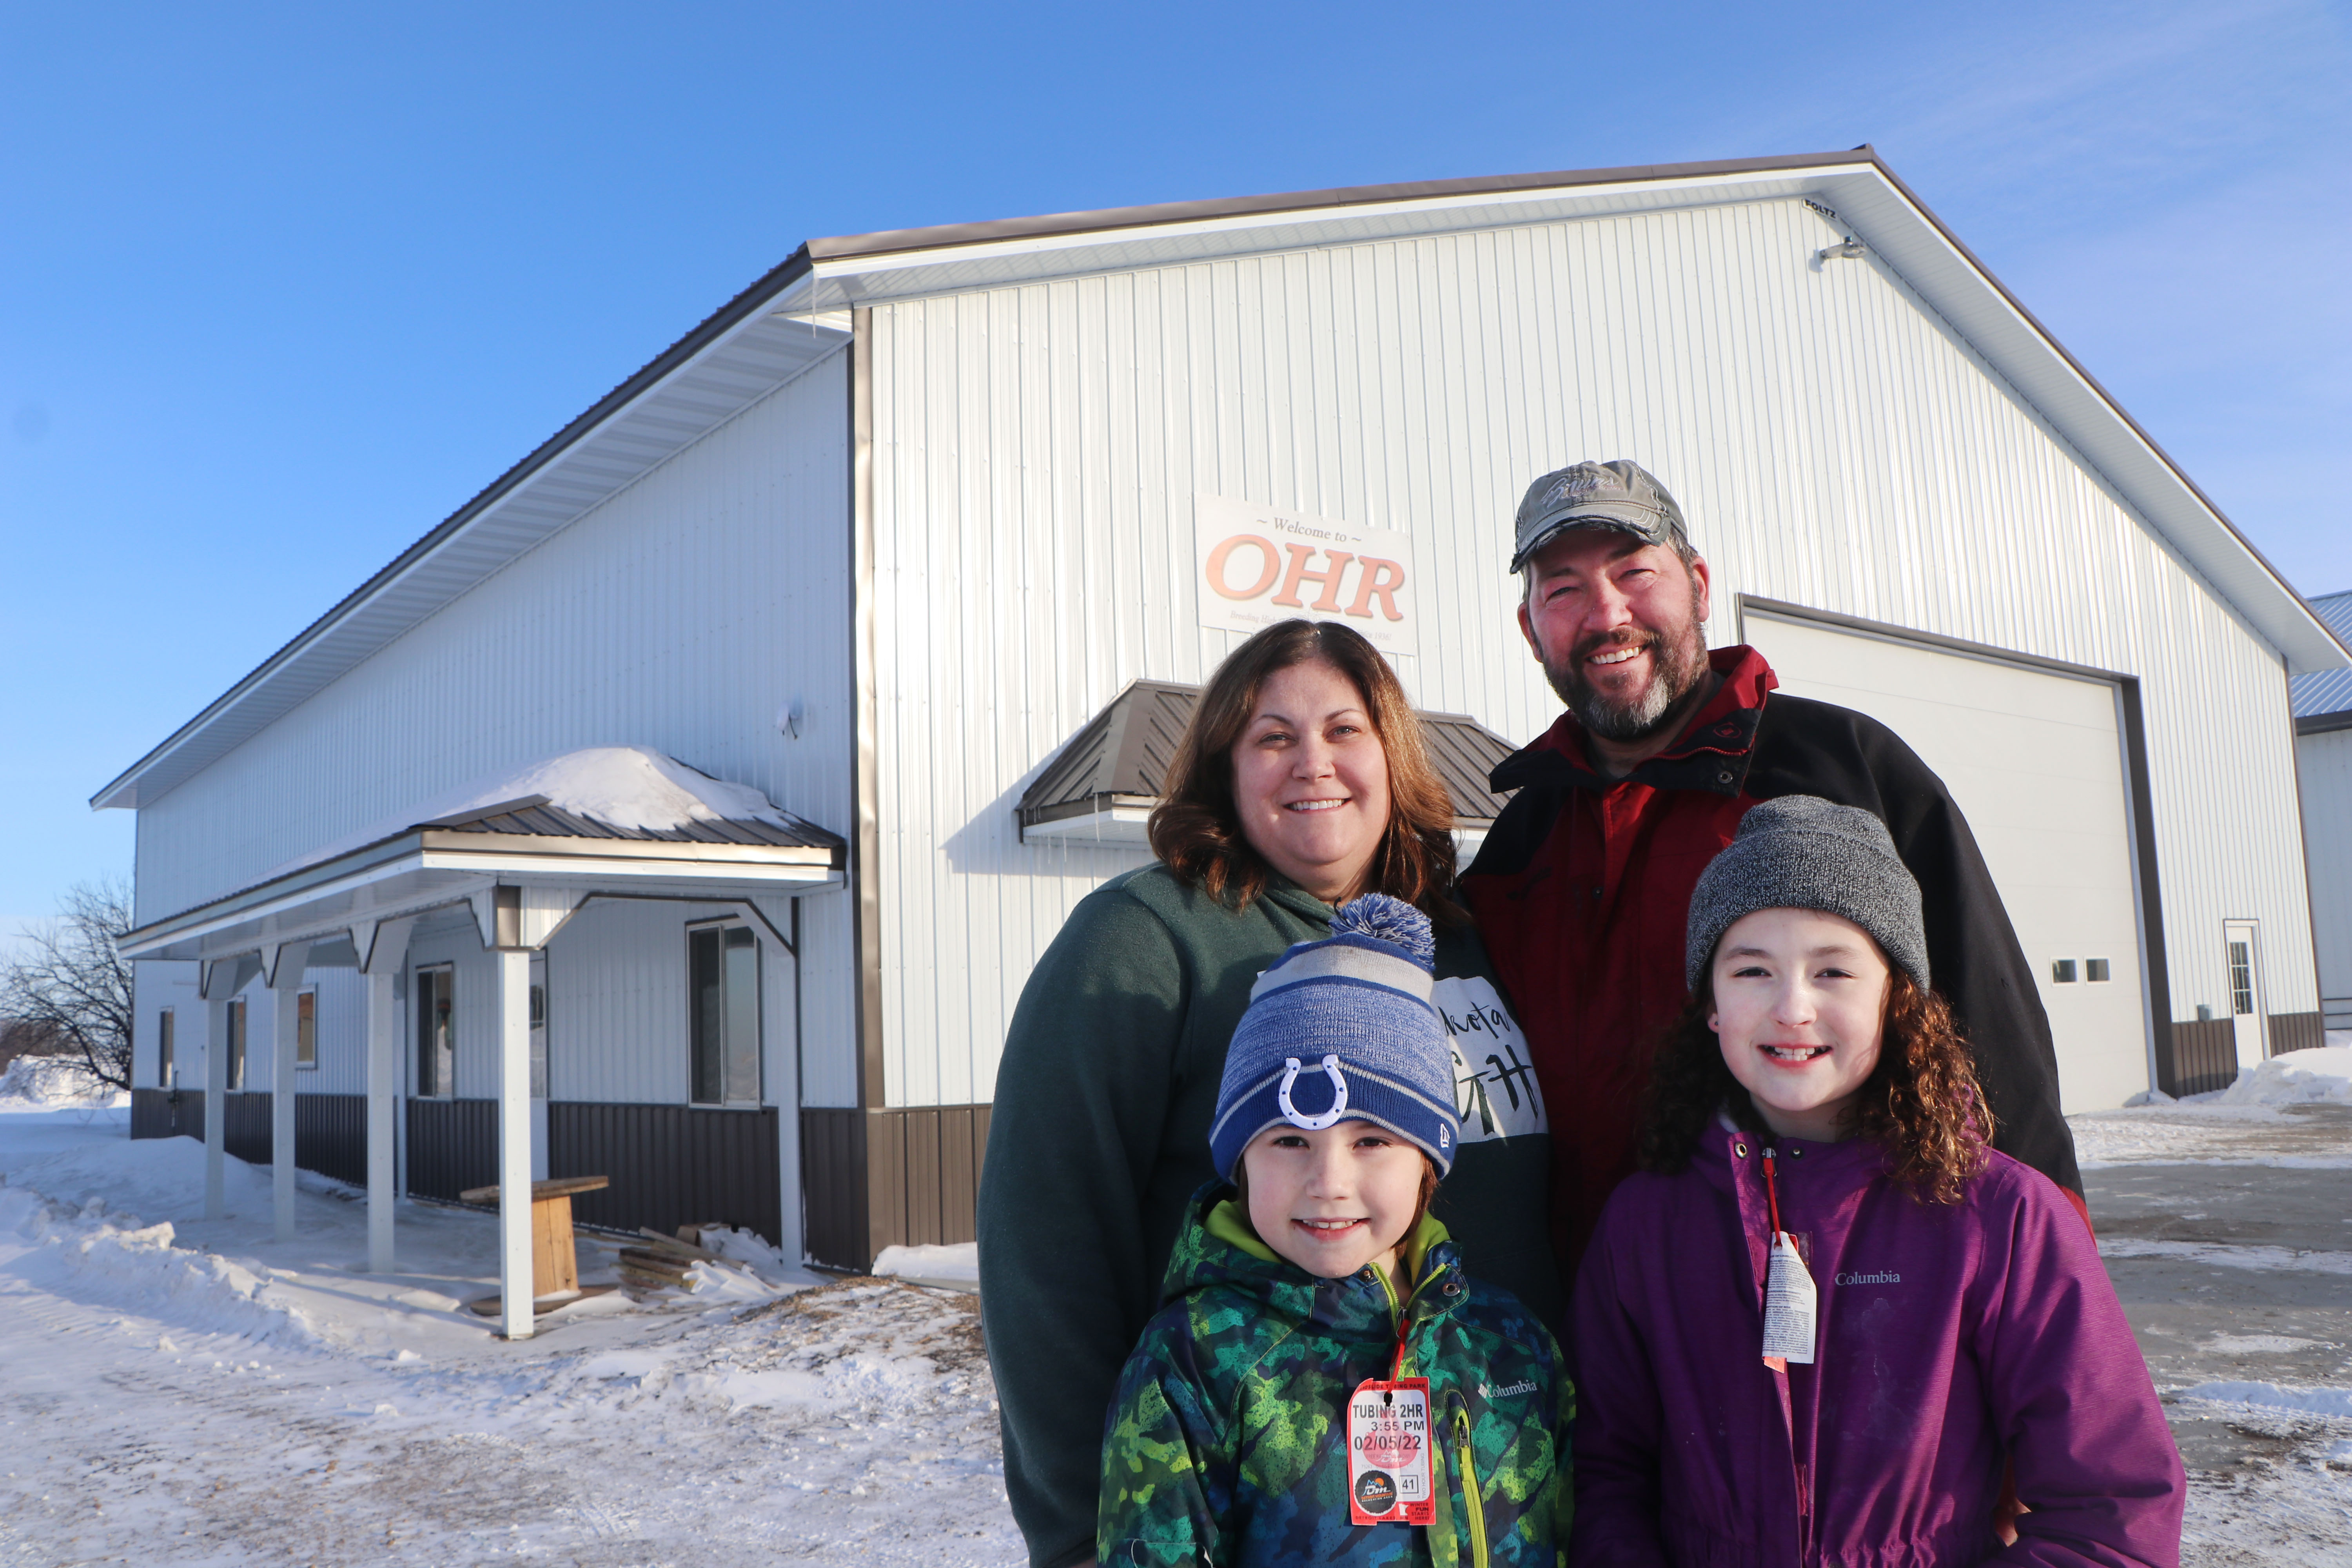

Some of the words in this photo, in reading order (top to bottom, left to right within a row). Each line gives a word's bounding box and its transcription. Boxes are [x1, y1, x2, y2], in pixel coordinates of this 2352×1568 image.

[1805, 198, 1836, 218] FOLTZ
[1274, 517, 1331, 539] Welcome
[1335, 532, 1347, 542] to
[1205, 534, 1405, 622] OHR
[1230, 610, 1259, 624] Breeding
[1835, 1270, 1900, 1285] Columbia
[1487, 1379, 1537, 1398] Columbia
[1353, 1404, 1396, 1418] TUBING
[1400, 1404, 1423, 1418] 2HR
[1371, 1421, 1399, 1431] 3:55
[1404, 1421, 1424, 1431] PM
[1354, 1435, 1421, 1450] 02/05/22
[1402, 1479, 1414, 1490] 41
